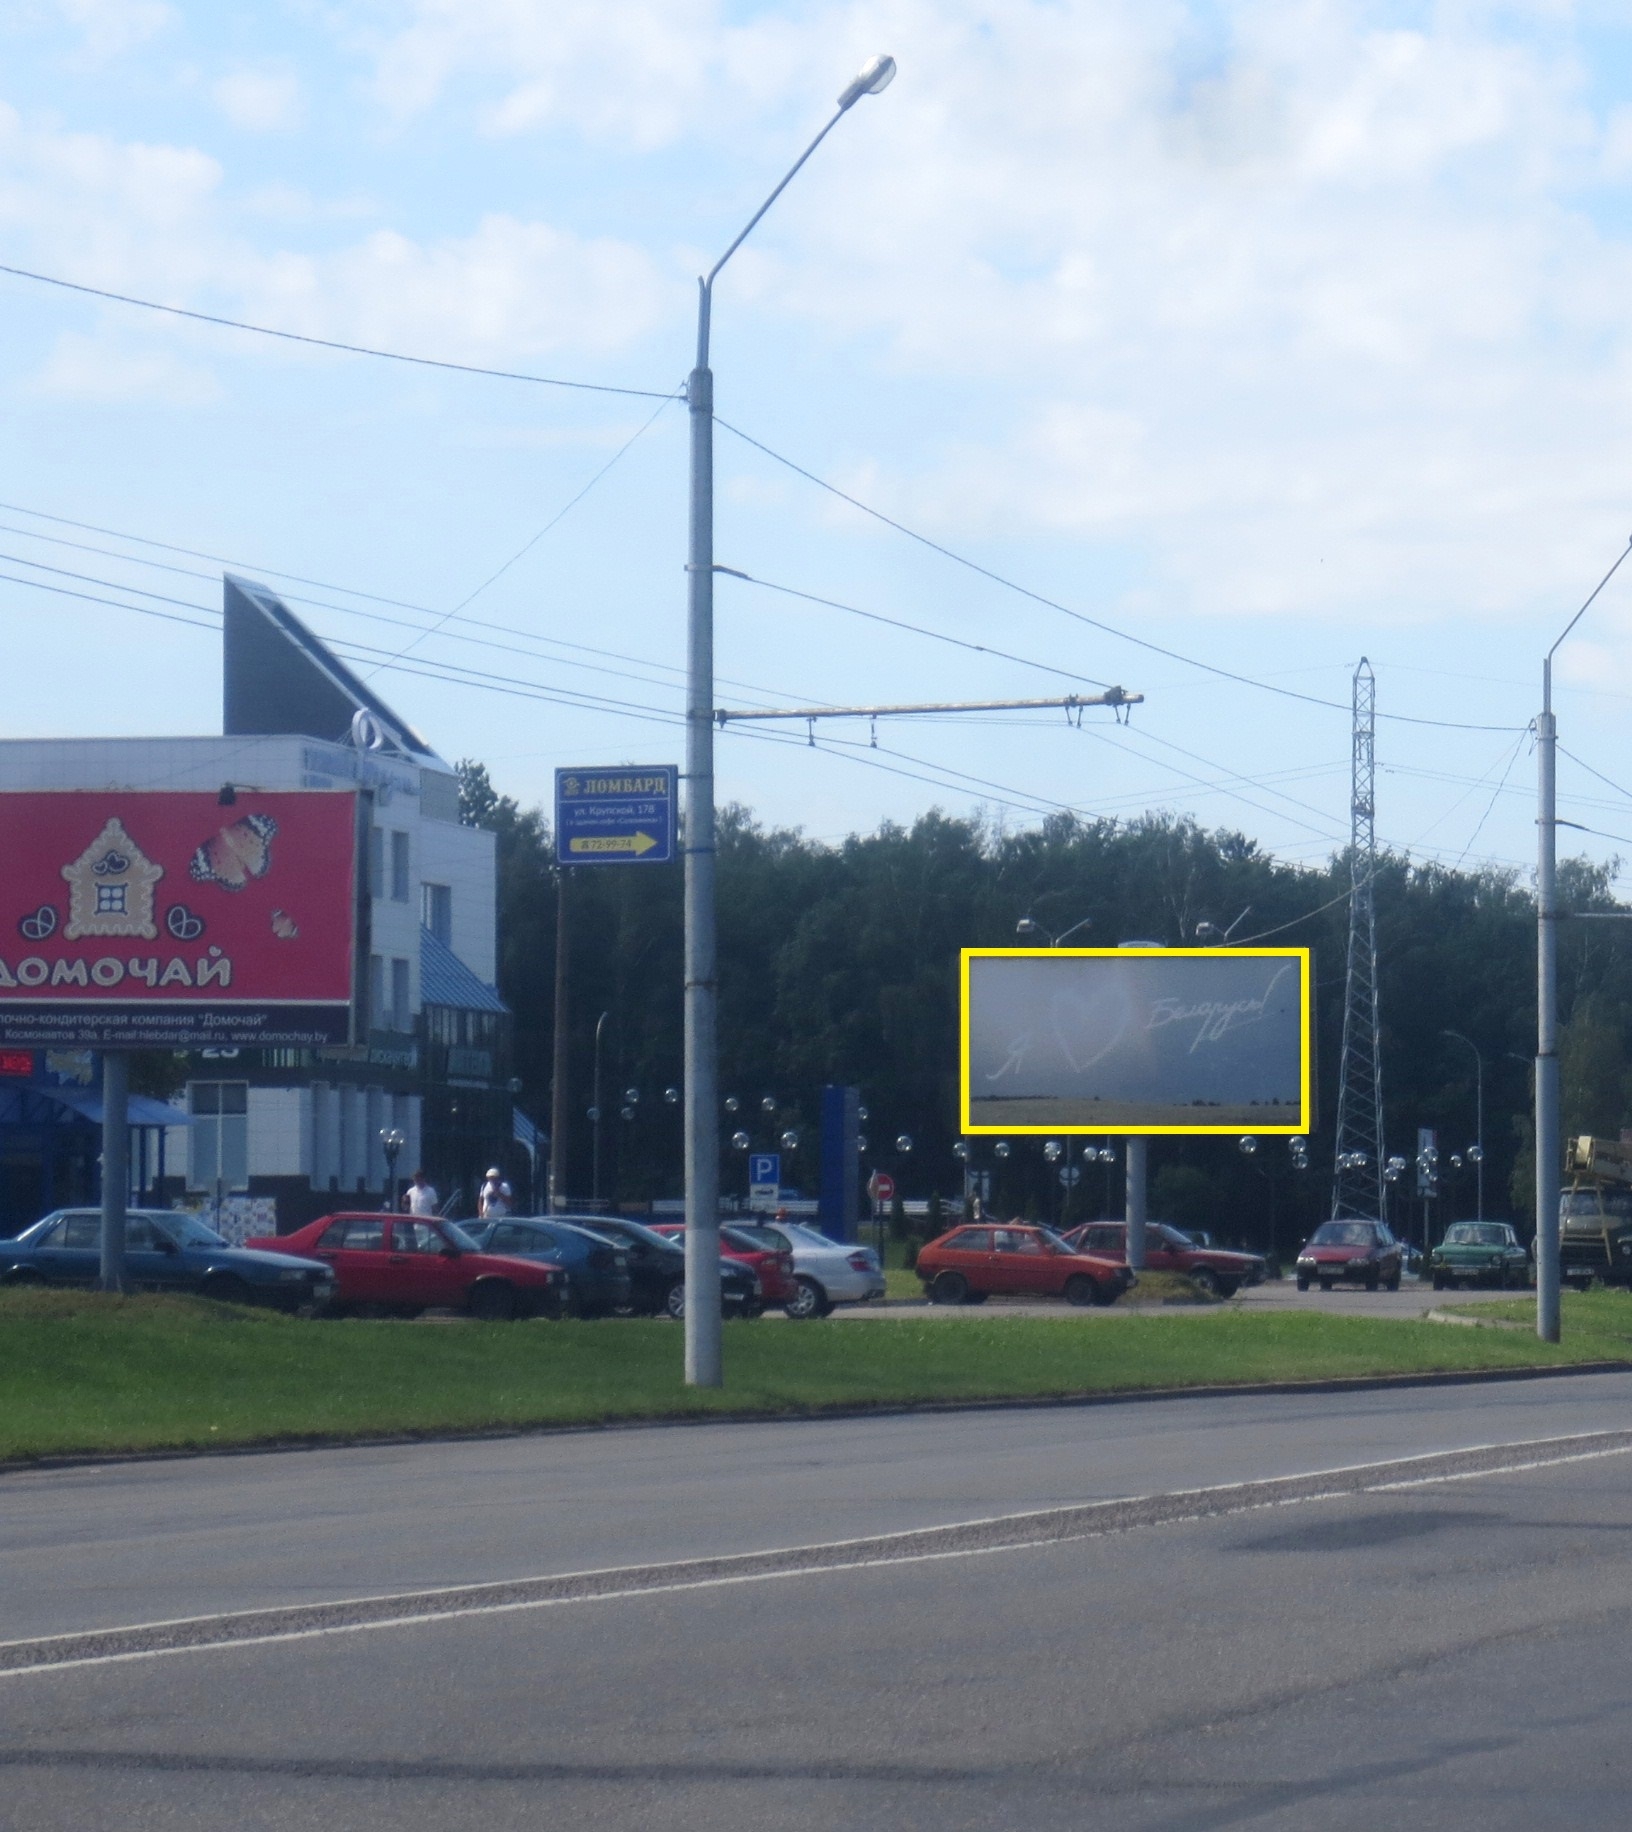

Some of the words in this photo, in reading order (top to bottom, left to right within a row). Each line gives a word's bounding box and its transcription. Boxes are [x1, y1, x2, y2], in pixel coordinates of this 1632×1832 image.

[583, 777, 666, 795] ЛОМБАРД
[131, 1015, 194, 1026] компания
[4, 1029, 76, 1040] Космонавтов
[231, 1030, 328, 1043] www.domochay.by
